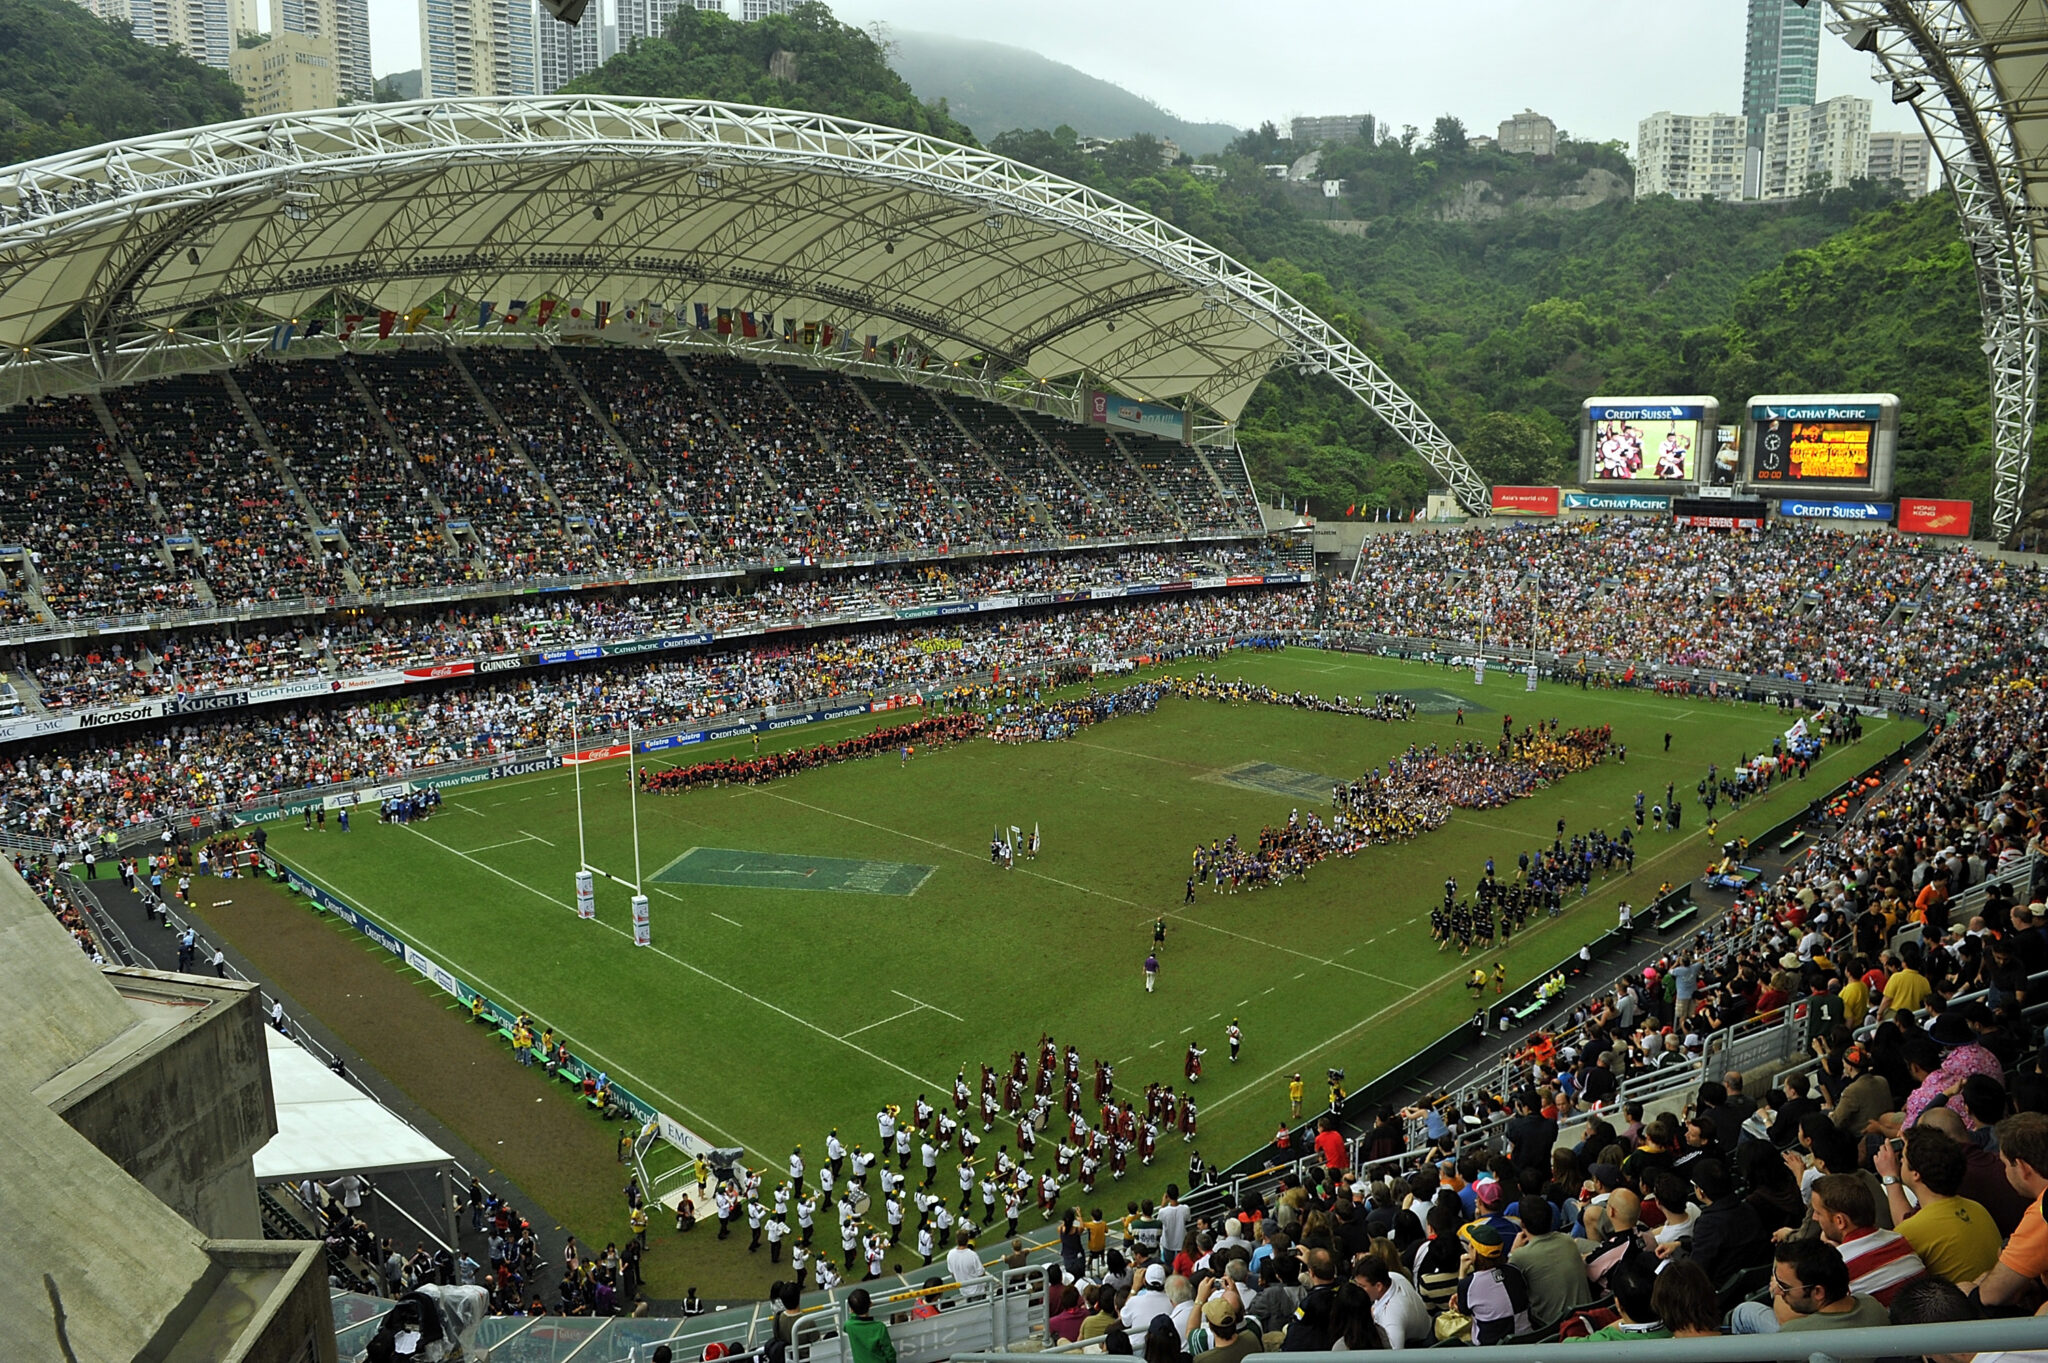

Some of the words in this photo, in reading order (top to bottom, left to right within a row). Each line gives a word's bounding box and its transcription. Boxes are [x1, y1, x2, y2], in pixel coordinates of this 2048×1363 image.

[1605, 409, 1640, 420] CREDIT
[1642, 410, 1672, 420] SUISSE
[1787, 408, 1827, 419] CATHAY
[1828, 408, 1866, 419] PACIFIC
[1590, 498, 1629, 509] CATHAY
[1630, 499, 1667, 509] PACIFIC
[1792, 504, 1832, 517] CREDIT
[1833, 505, 1866, 518] SUISSE
[1708, 516, 1733, 527] SEVENS
[1025, 596, 1050, 605] KUKRI
[614, 645, 637, 654] CATHAY
[638, 642, 659, 652] PACIFIC
[663, 638, 683, 648] CREDIT
[684, 637, 701, 646] SUISSE
[480, 658, 521, 673] GUINNESS
[349, 679, 376, 687] Modern
[250, 682, 328, 699] LIGHTHOUSE
[178, 693, 234, 713] KUKRI
[80, 706, 152, 728] Microsoft
[824, 711, 845, 721] CREDIT
[846, 708, 860, 718] SUISSE
[769, 720, 790, 730] CREDIT
[790, 717, 808, 727] SUISSE
[710, 730, 732, 741] CREDIT
[733, 727, 751, 737] SUISSE
[503, 759, 550, 777] KUKRI
[428, 777, 459, 789] CATHAY
[460, 772, 490, 786] PACIFIC
[255, 809, 290, 822] CATHY
[292, 803, 323, 815] PACFIC
[325, 898, 342, 915] CREDIT
[340, 907, 353, 924] SUISSE
[365, 924, 384, 941] CREDIT
[381, 935, 397, 954] SUISSE
[1820, 1004, 1831, 1020] 1
